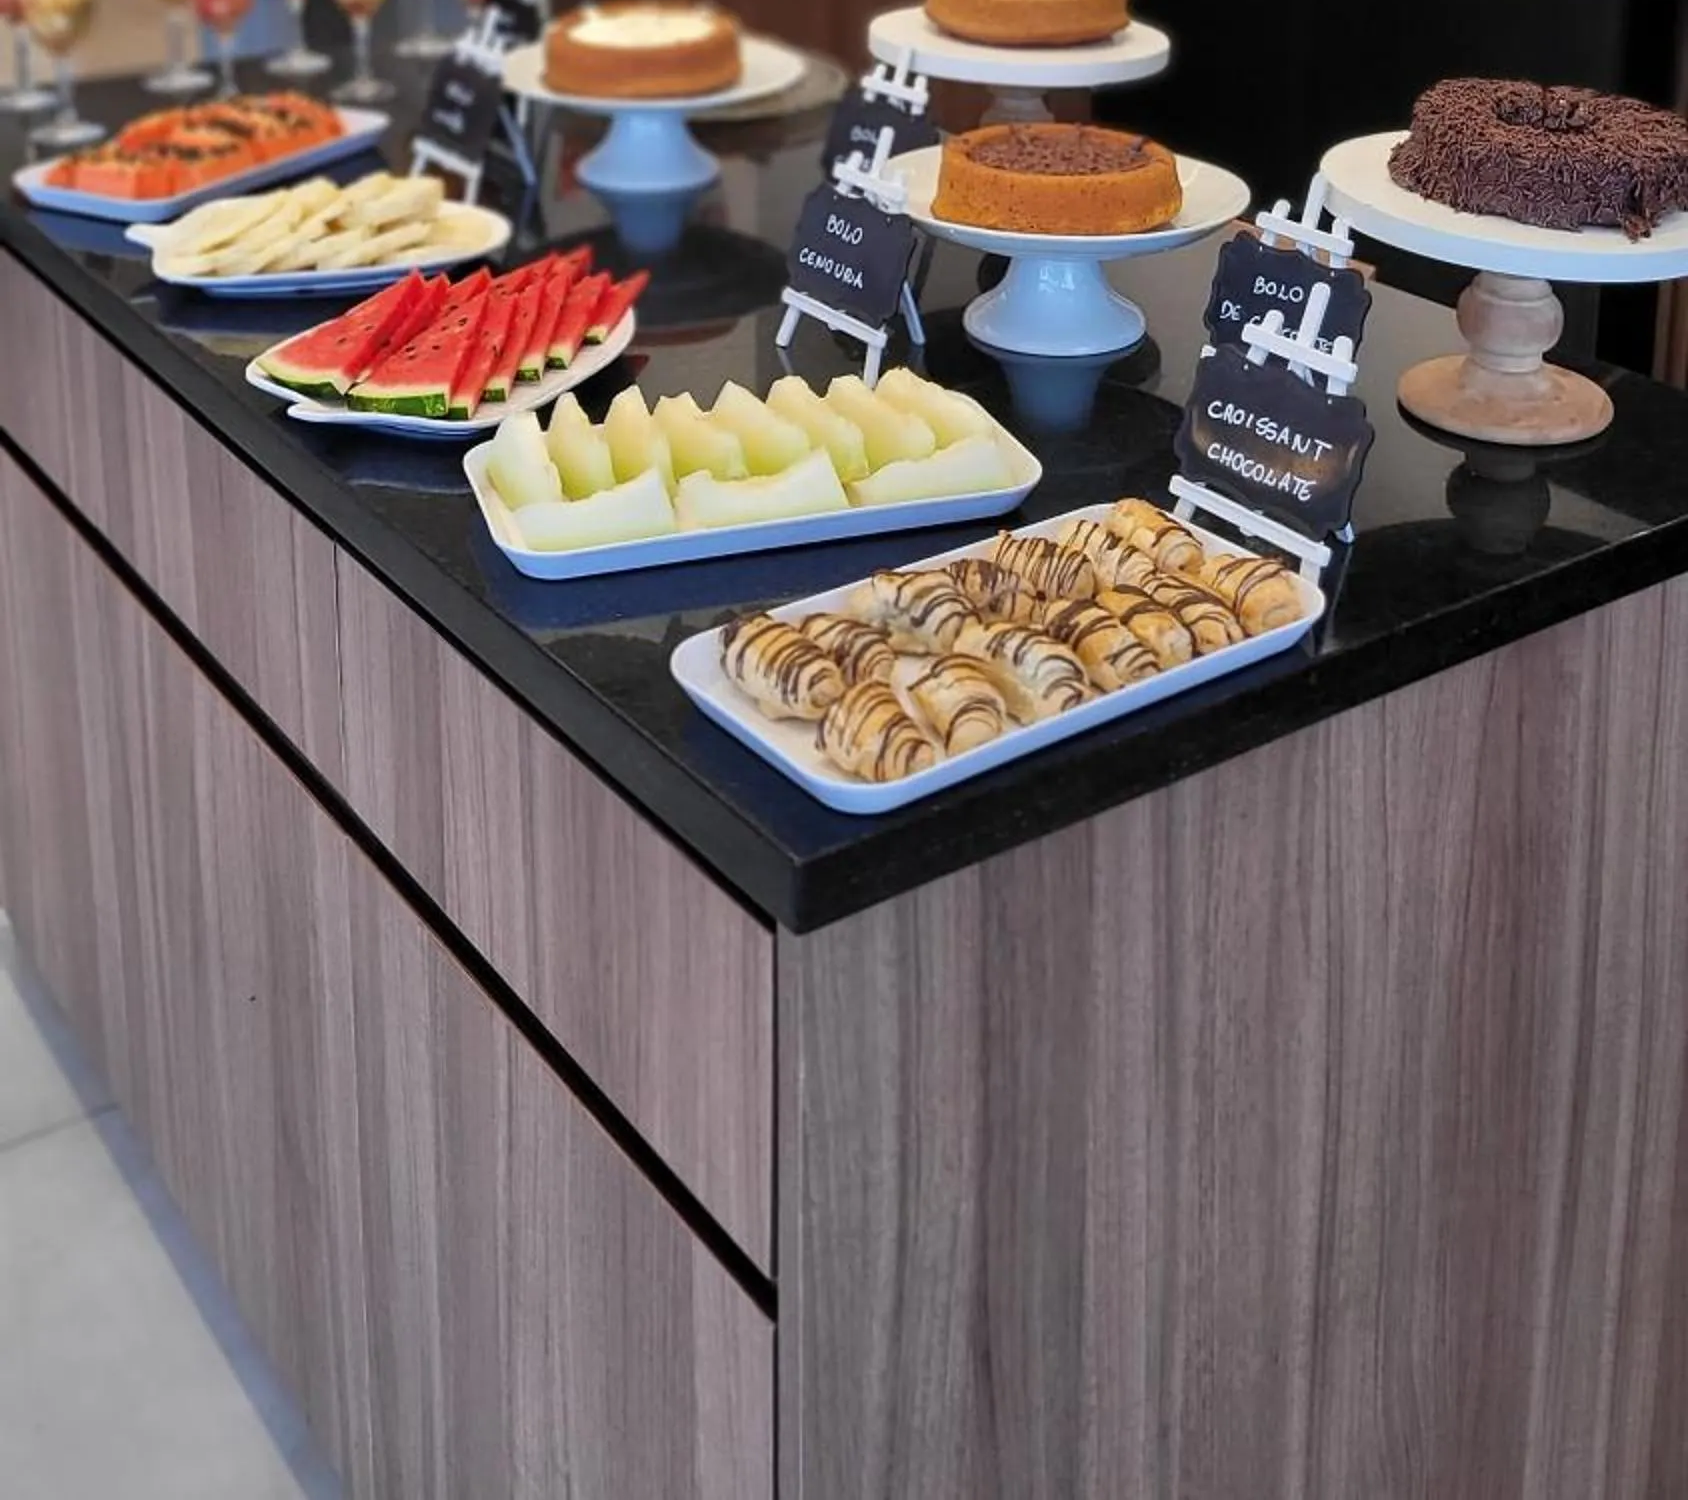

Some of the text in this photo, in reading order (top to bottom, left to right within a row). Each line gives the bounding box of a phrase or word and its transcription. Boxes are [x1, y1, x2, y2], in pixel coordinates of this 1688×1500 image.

[826, 213, 863, 245] BOLO
[799, 247, 863, 289] CENOURA
[1253, 275, 1304, 302] BOLO
[1220, 299, 1242, 321] DE
[1207, 400, 1333, 461] CROISSANT
[1207, 443, 1317, 501] CHOCOLATE
